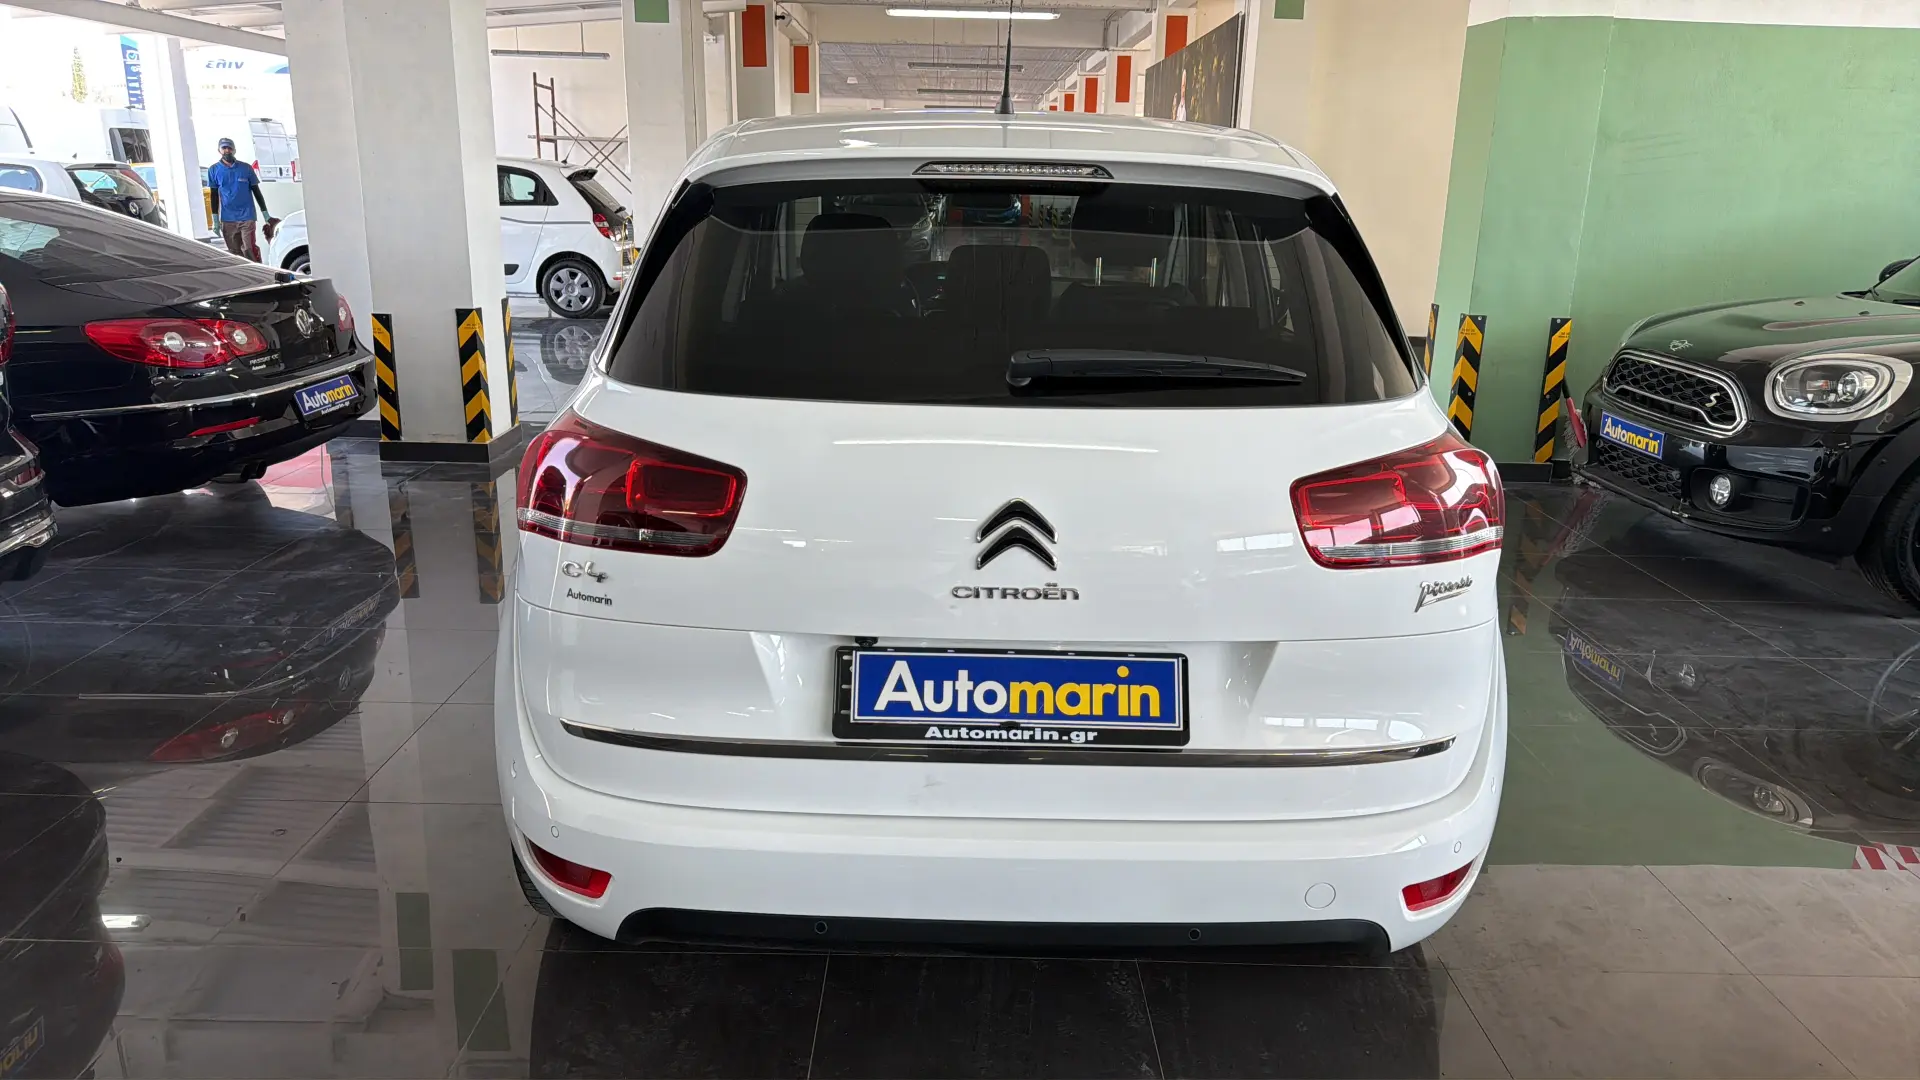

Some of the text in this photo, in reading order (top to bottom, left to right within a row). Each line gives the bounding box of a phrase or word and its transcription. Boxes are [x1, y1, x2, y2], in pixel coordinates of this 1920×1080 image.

[302, 380, 355, 411] Automarin
[1603, 416, 1660, 454] Automarin
[561, 560, 608, 583] C4
[566, 588, 613, 606] Automarin
[873, 659, 1161, 718] Automarin
[924, 725, 1098, 744] Automarin.gr
